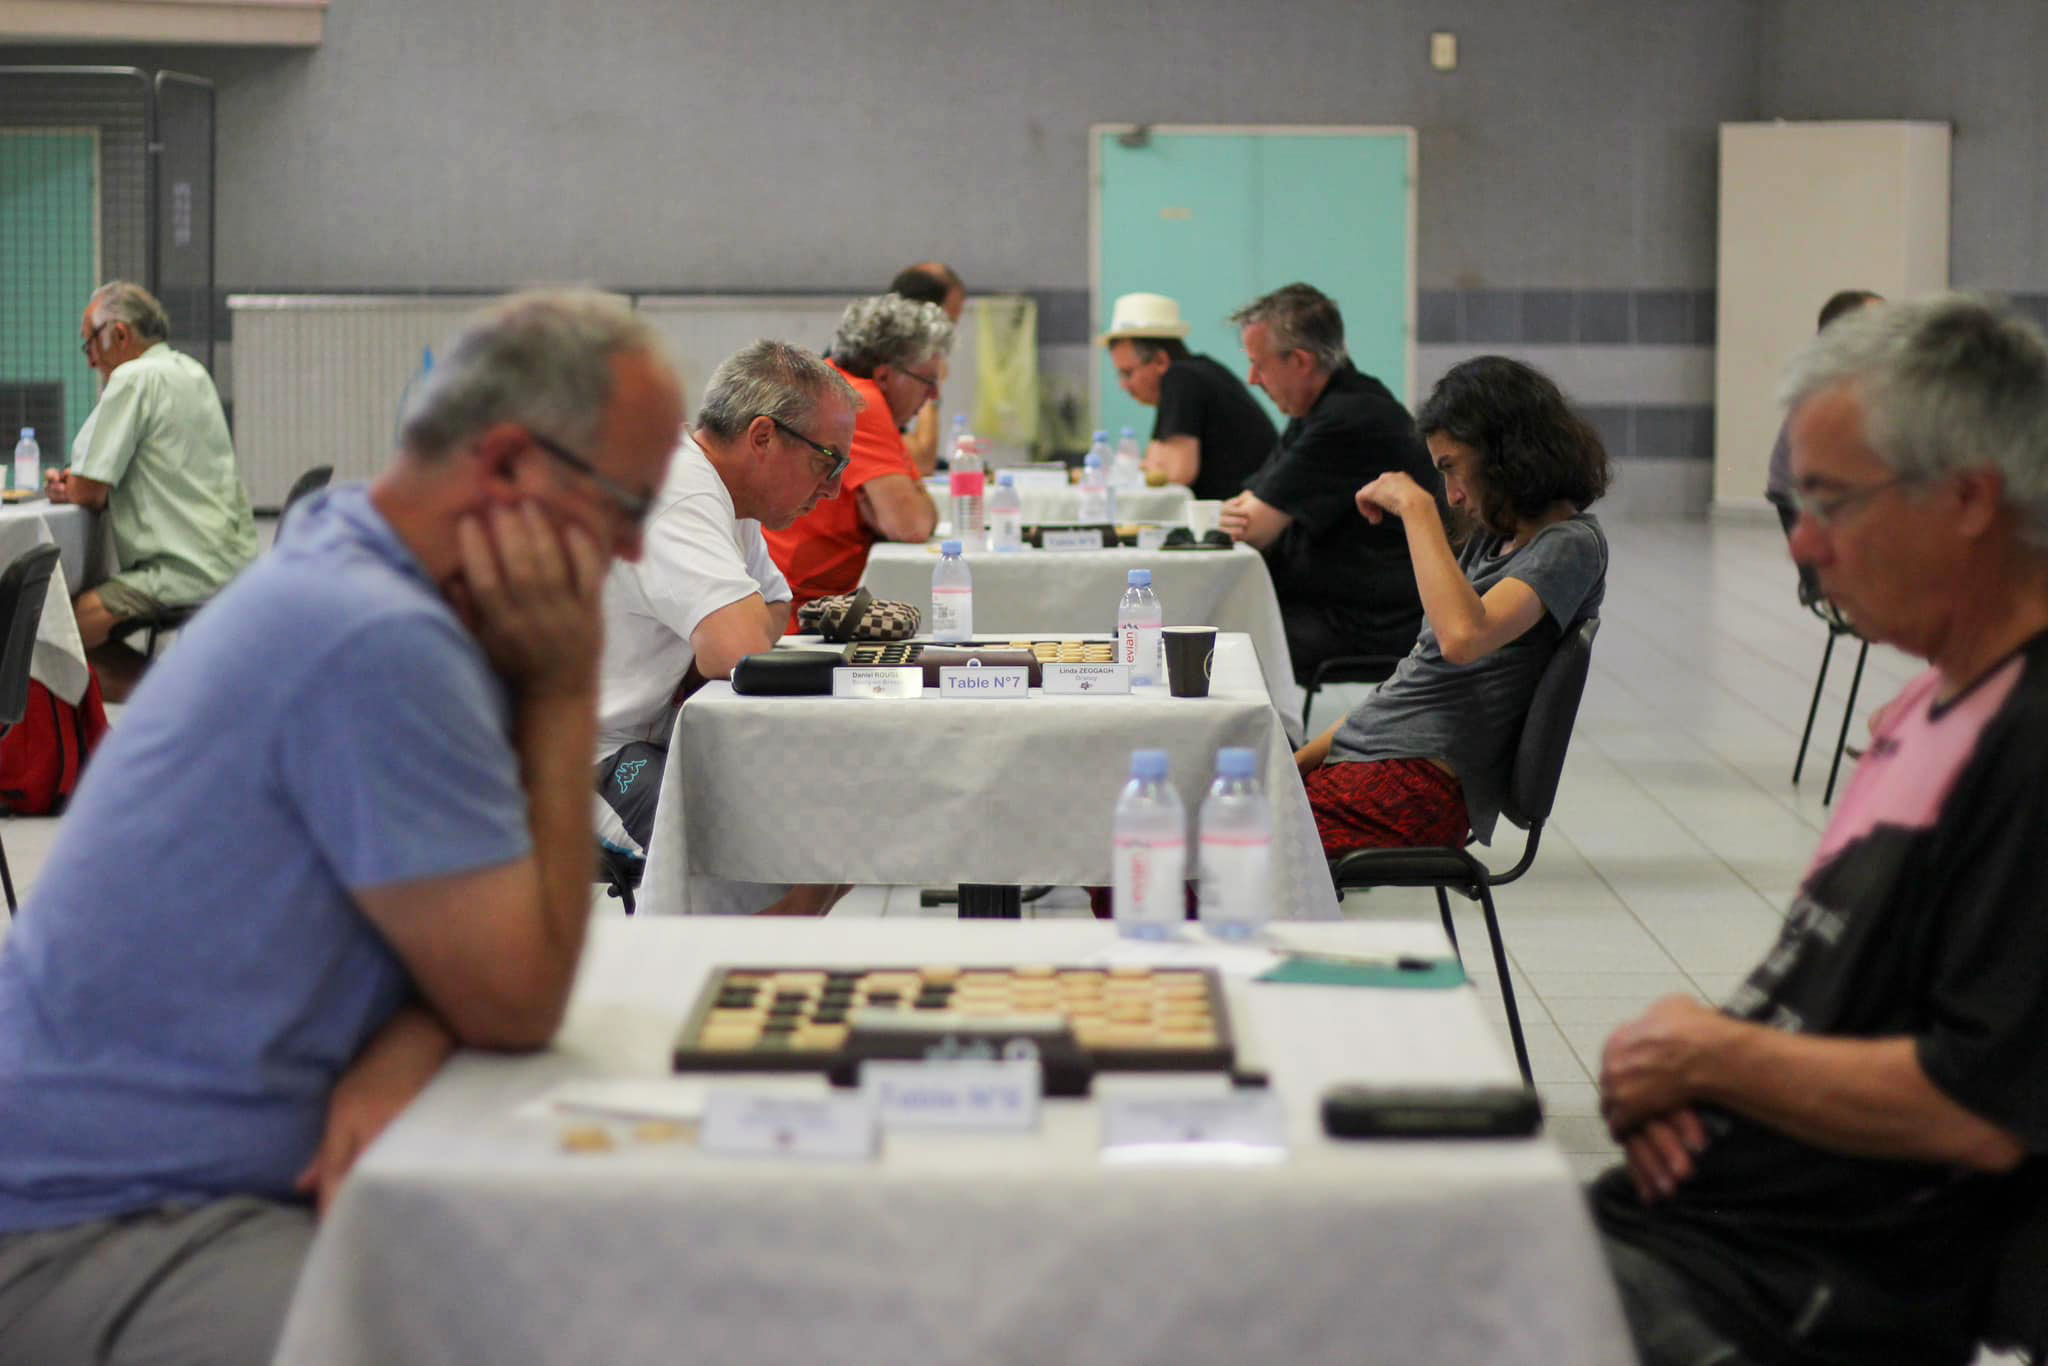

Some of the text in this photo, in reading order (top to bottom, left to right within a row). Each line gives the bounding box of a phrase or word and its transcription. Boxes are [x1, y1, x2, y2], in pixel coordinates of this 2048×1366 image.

[1126, 631, 1135, 663] evian
[947, 676, 1020, 688] Table N°7
